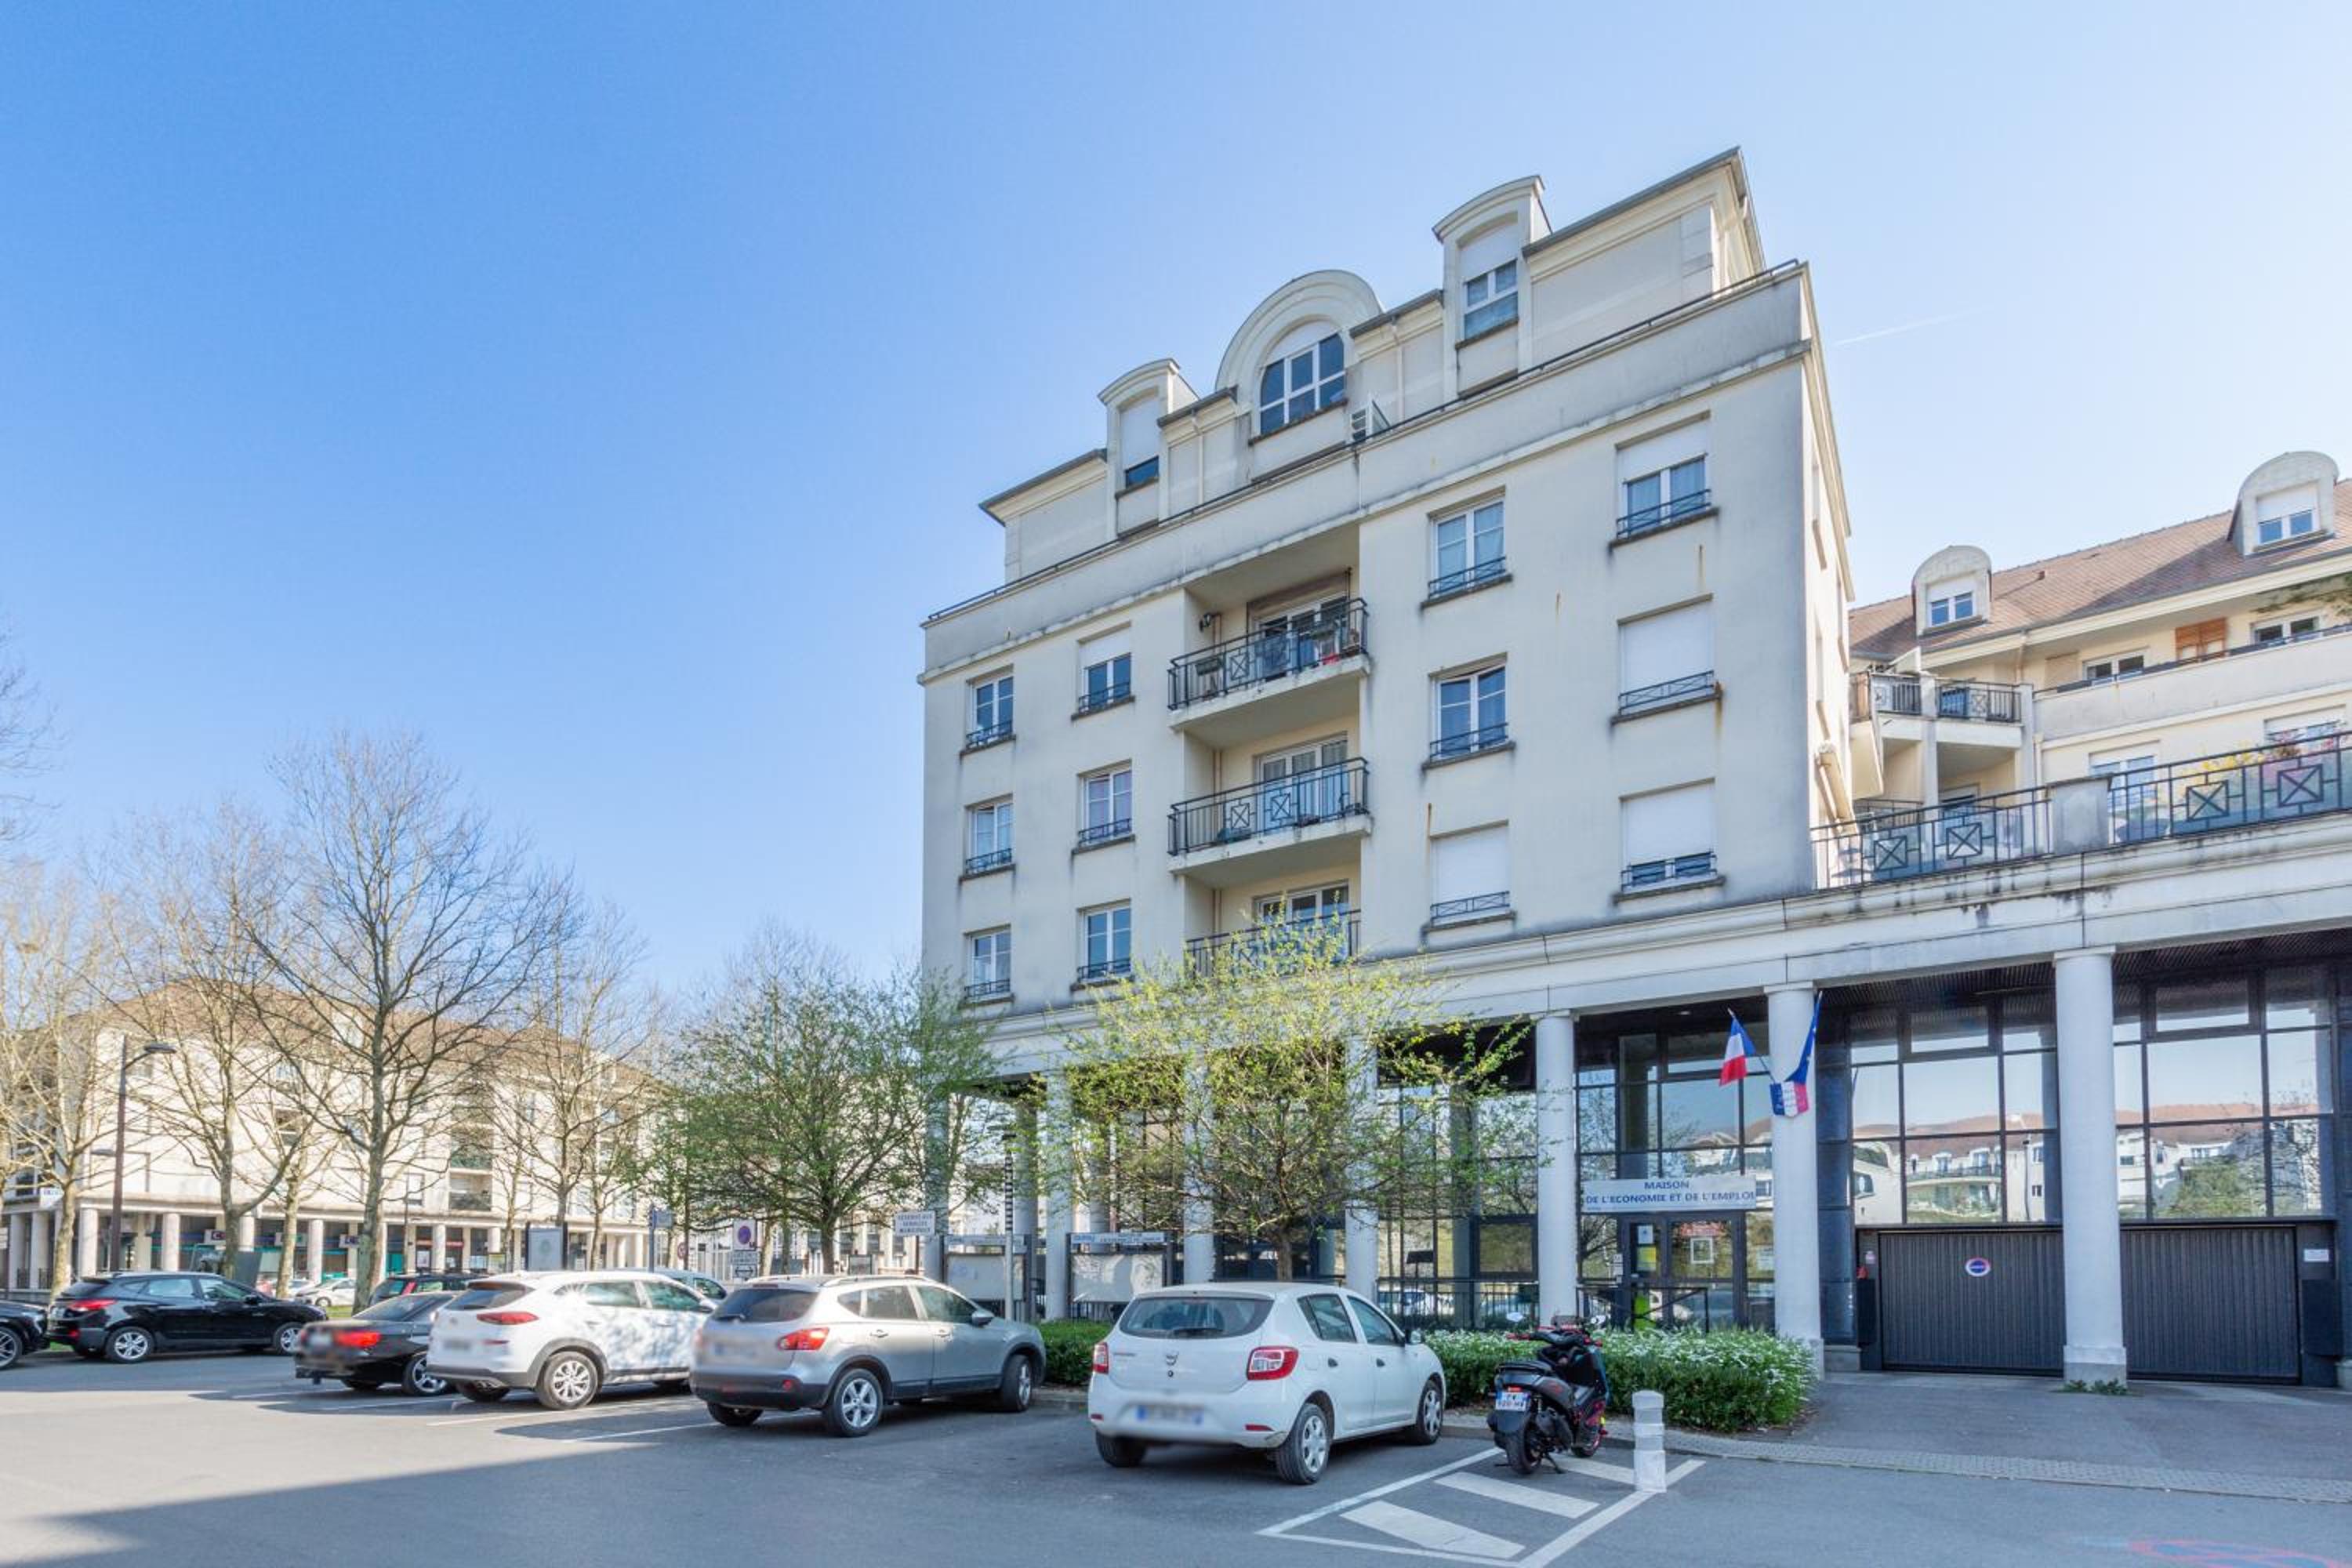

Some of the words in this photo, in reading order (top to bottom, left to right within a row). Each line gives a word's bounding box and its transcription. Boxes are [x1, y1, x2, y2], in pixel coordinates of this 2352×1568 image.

[1644, 1181, 1690, 1189] MAISON
[1670, 1192, 1681, 1202] ET
[1686, 1192, 1698, 1201] DE
[1702, 1191, 1755, 1201] L'EMPLOI
